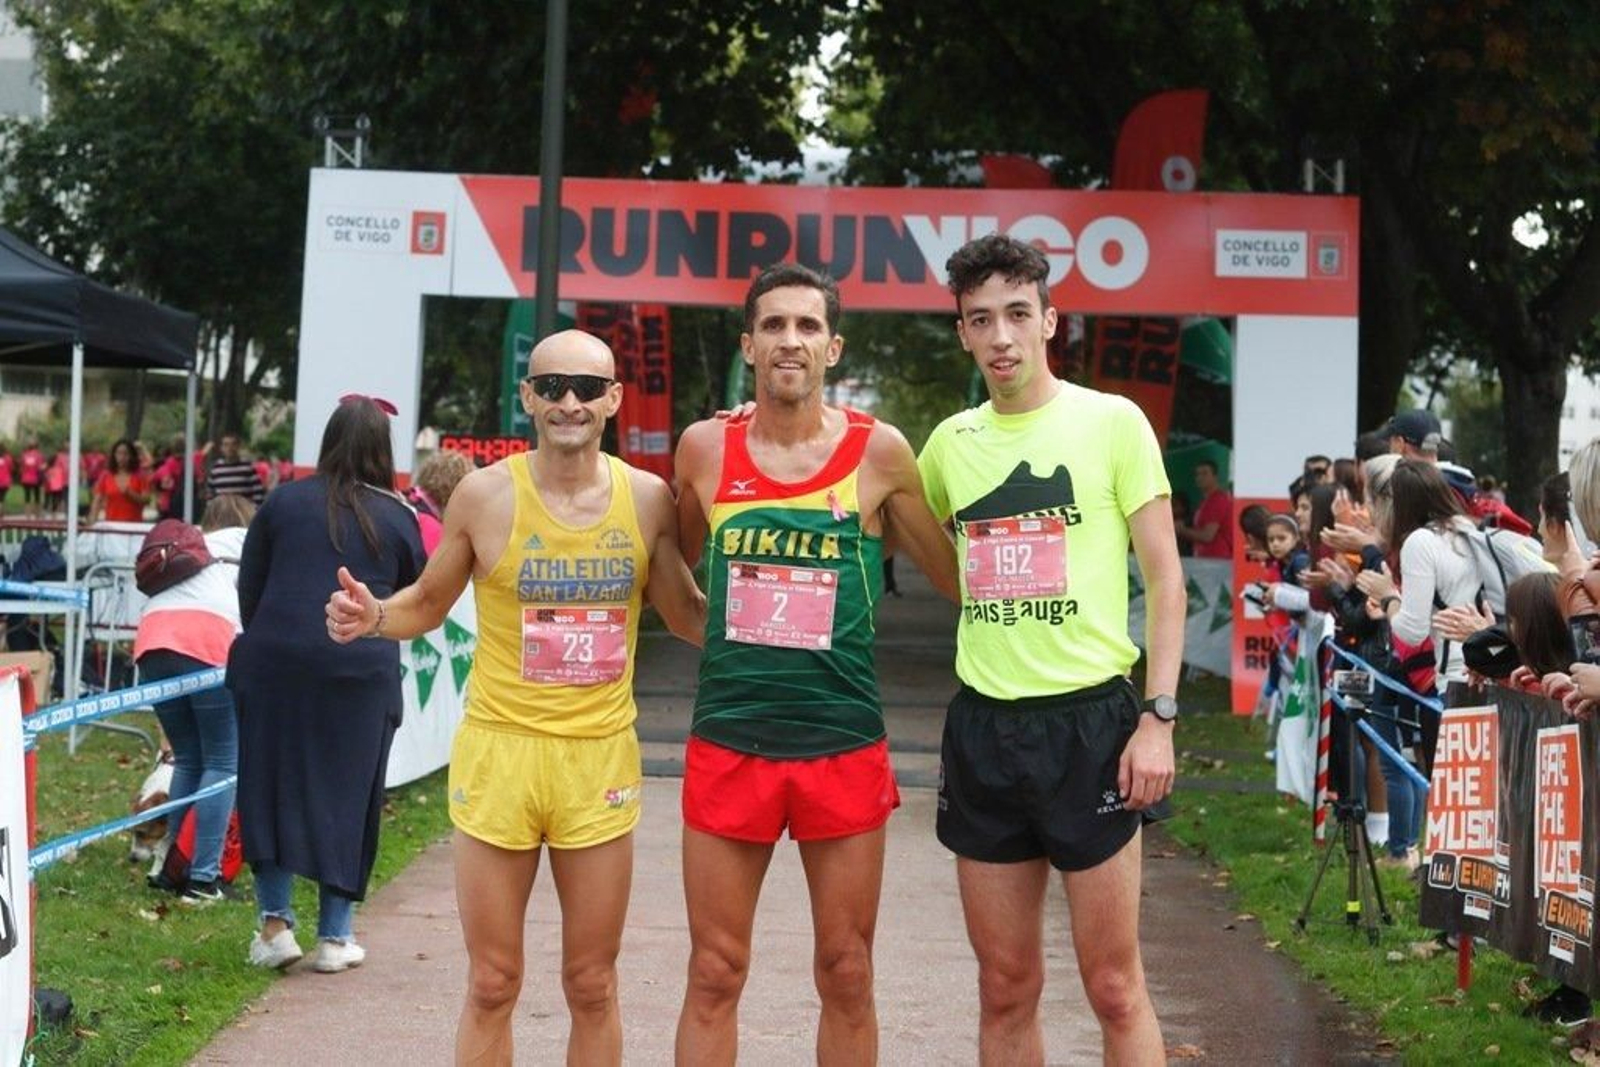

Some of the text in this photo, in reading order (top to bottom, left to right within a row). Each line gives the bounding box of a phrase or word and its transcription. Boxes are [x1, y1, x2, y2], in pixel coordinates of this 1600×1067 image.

[325, 214, 401, 230] CONCELLO
[333, 230, 392, 244] DE VIGO
[521, 205, 1149, 291] RUNRUNVGO
[1223, 239, 1300, 253] CONCELLO
[1231, 254, 1291, 268] DE VIGO
[722, 528, 842, 560] BIKILA
[519, 556, 635, 579] ATHLETICS
[994, 544, 1033, 576] 192
[519, 583, 558, 601] SAN
[771, 592, 788, 622] 2
[1020, 599, 1079, 625] auga
[562, 633, 594, 663] 23
[1433, 722, 1491, 763] SAVE
[1431, 766, 1482, 807] THE
[1425, 809, 1495, 852] MUSC
